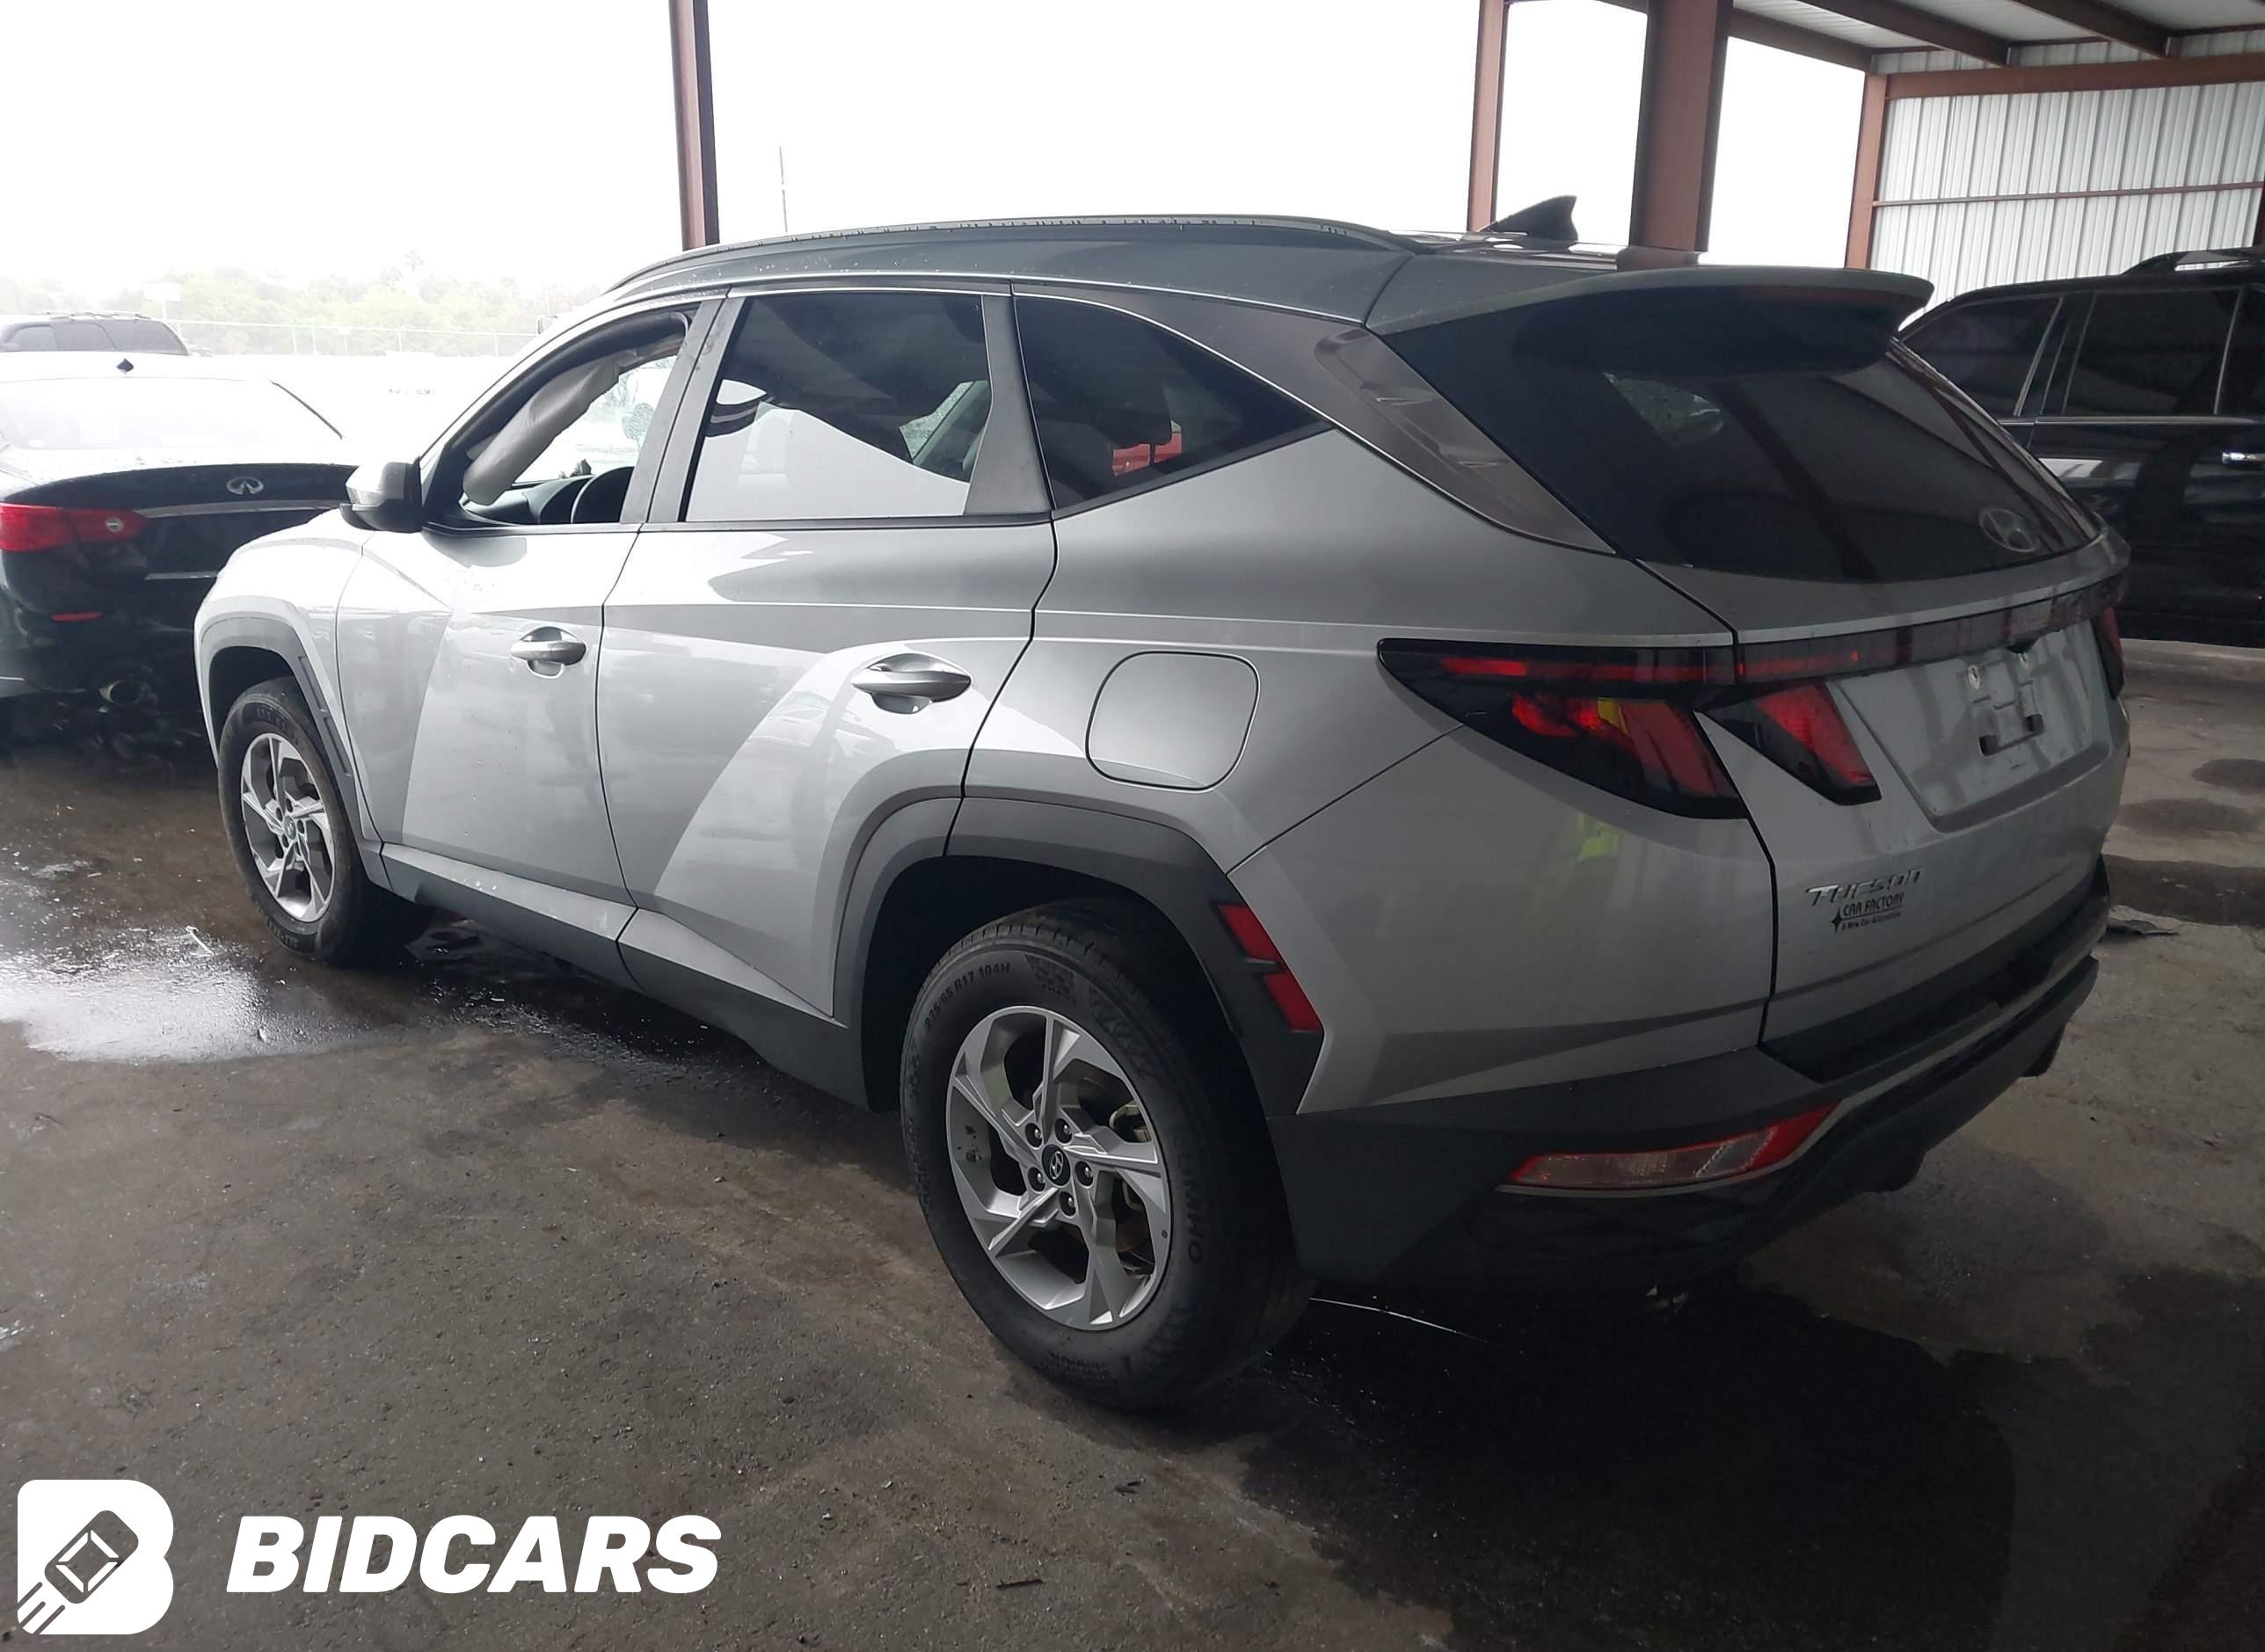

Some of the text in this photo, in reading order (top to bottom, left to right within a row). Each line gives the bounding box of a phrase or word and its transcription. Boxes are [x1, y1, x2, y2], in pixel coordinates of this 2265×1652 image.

[1842, 892, 1904, 916] CAR FACTORY
[954, 971, 975, 992] R17
[979, 963, 1011, 979] 104H
